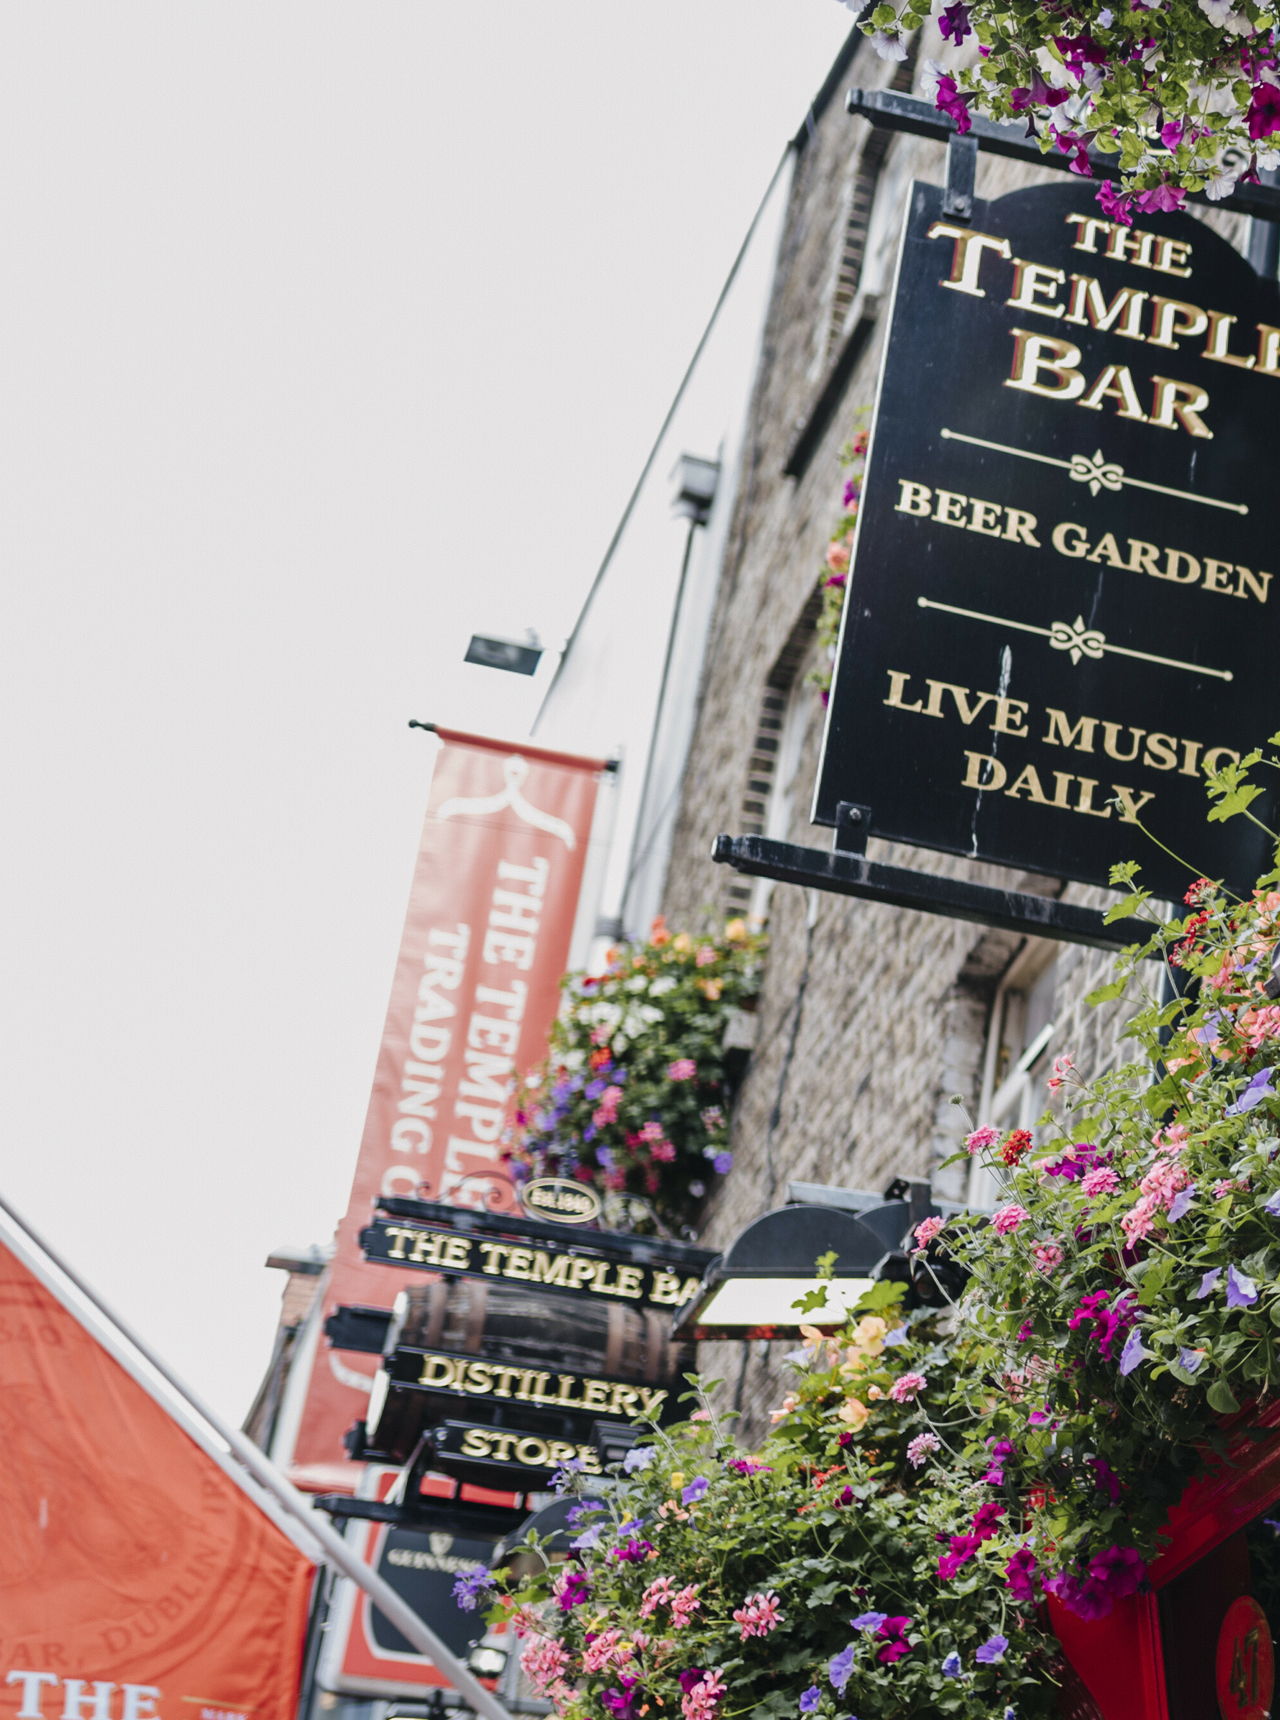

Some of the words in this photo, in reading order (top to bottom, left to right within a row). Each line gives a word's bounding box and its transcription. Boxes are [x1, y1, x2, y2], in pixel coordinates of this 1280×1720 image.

[1066, 213, 1192, 278] THE
[1004, 327, 1213, 440] BAR
[895, 479, 1041, 548] BEER
[1052, 523, 1273, 604] GARDEN
[883, 670, 1029, 737] LIVE
[1044, 709, 1241, 778] MUSIC
[961, 750, 1155, 823] DAILY
[482, 856, 549, 970] THE
[390, 922, 470, 1154] TRADING
[438, 979, 529, 1211] TEMPLE
[385, 1227, 471, 1270] THE
[480, 1244, 645, 1299] TEMPLE
[649, 1271, 702, 1307] BA
[418, 1354, 669, 1416] DISTILLERY
[461, 1429, 602, 1474] STORE
[5, 1670, 162, 1720] THE
[1229, 1626, 1259, 1710] 47
